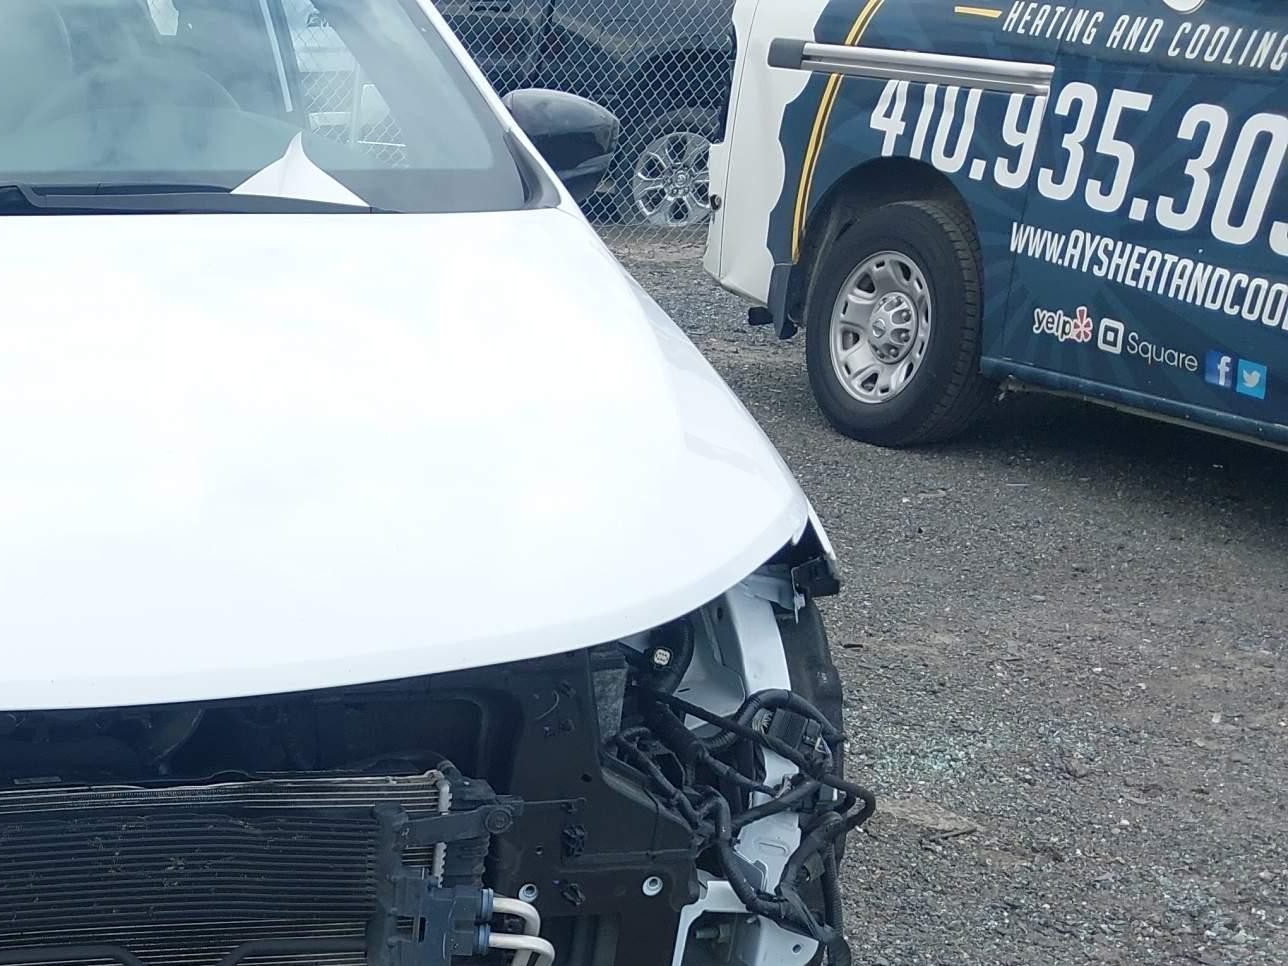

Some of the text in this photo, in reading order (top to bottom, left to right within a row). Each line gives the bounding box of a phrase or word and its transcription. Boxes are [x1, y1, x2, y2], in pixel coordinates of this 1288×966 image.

[1002, 0, 1288, 71] HEATING AND COOLING
[870, 79, 1288, 257] 410.935.30
[1010, 222, 1288, 331] WWW.AYSHEATANDCOO
[1033, 308, 1074, 342] yelp
[1126, 332, 1199, 372] Square
